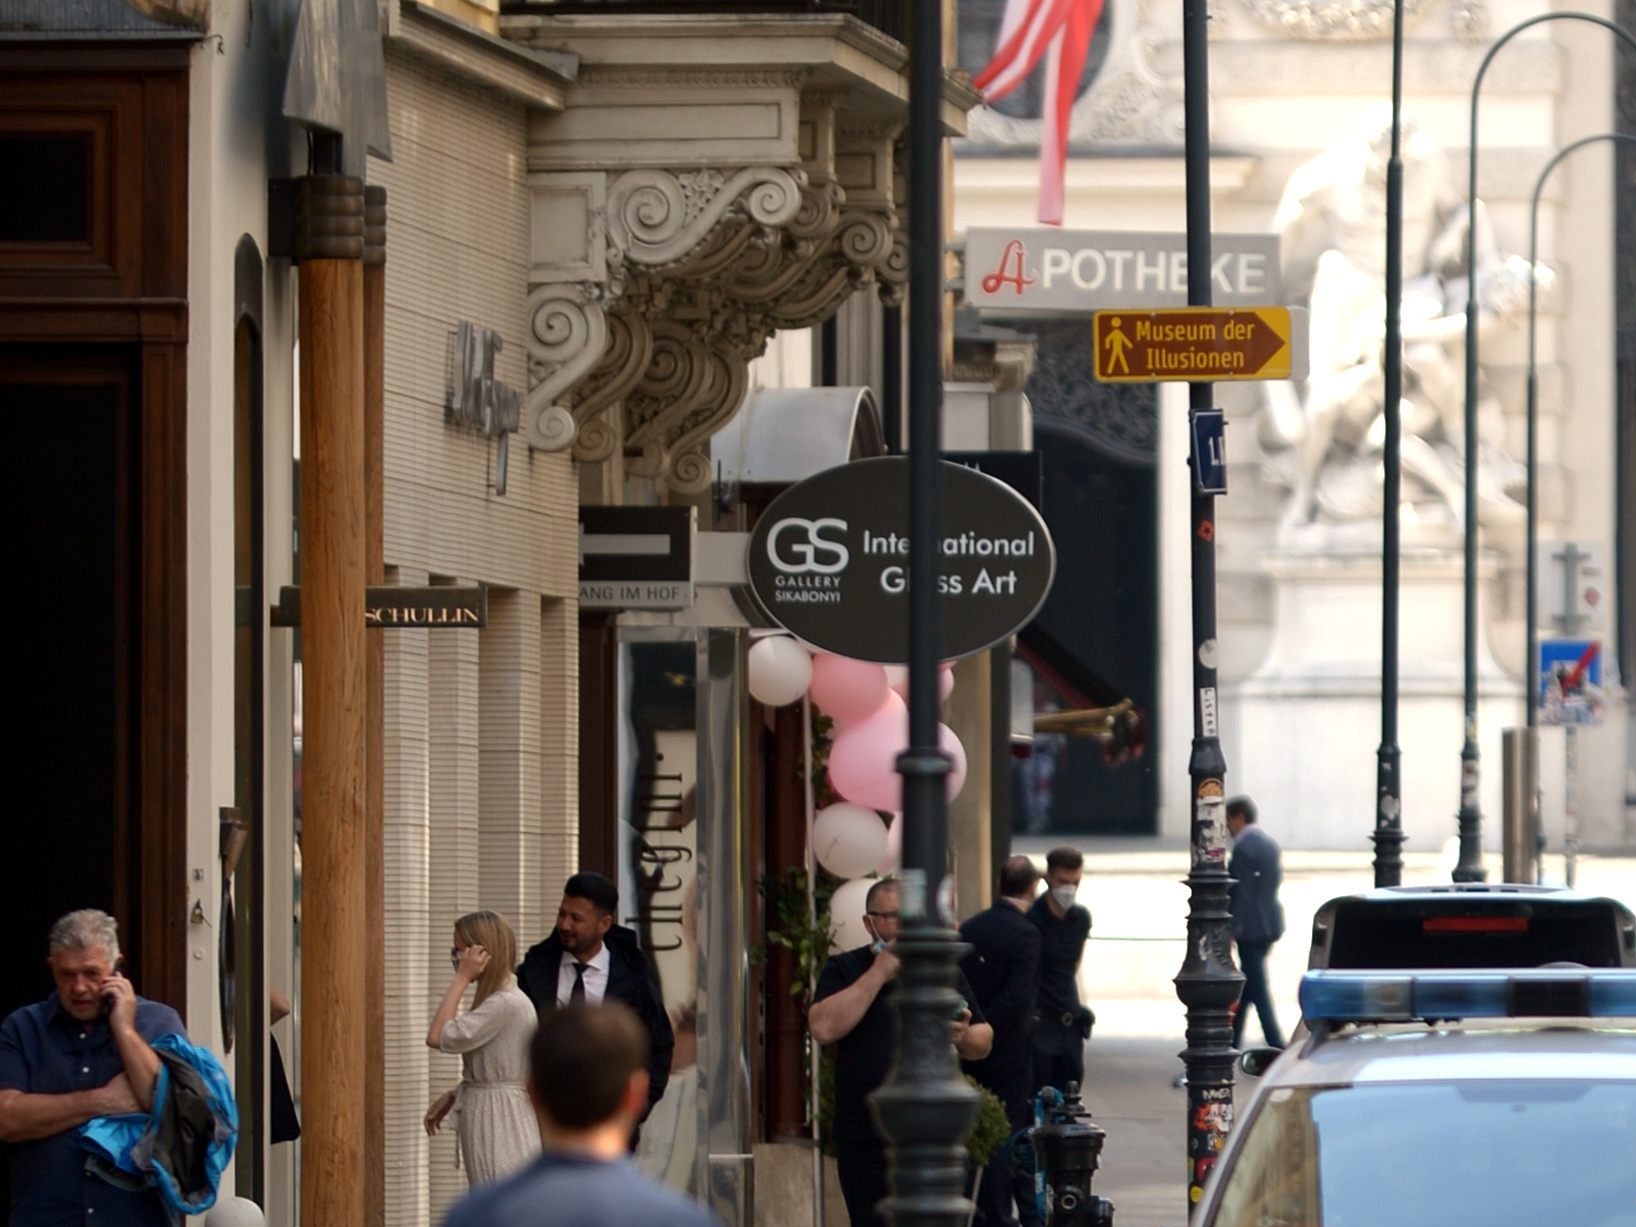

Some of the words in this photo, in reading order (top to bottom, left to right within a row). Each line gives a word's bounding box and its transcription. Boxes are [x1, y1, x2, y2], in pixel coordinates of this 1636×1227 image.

[1136, 320, 1216, 341] Museum
[1223, 319, 1256, 340] der
[1146, 347, 1245, 370] Illusionen
[766, 517, 849, 574] GS
[863, 530, 1035, 556] Inteational
[619, 582, 641, 600] IM
[646, 582, 681, 600] HOF
[775, 575, 841, 588] GALLERY
[880, 566, 963, 594] Gss
[972, 567, 1018, 594] Art
[775, 590, 841, 603] SIKABONYI
[365, 607, 479, 623] SCHULLIN
